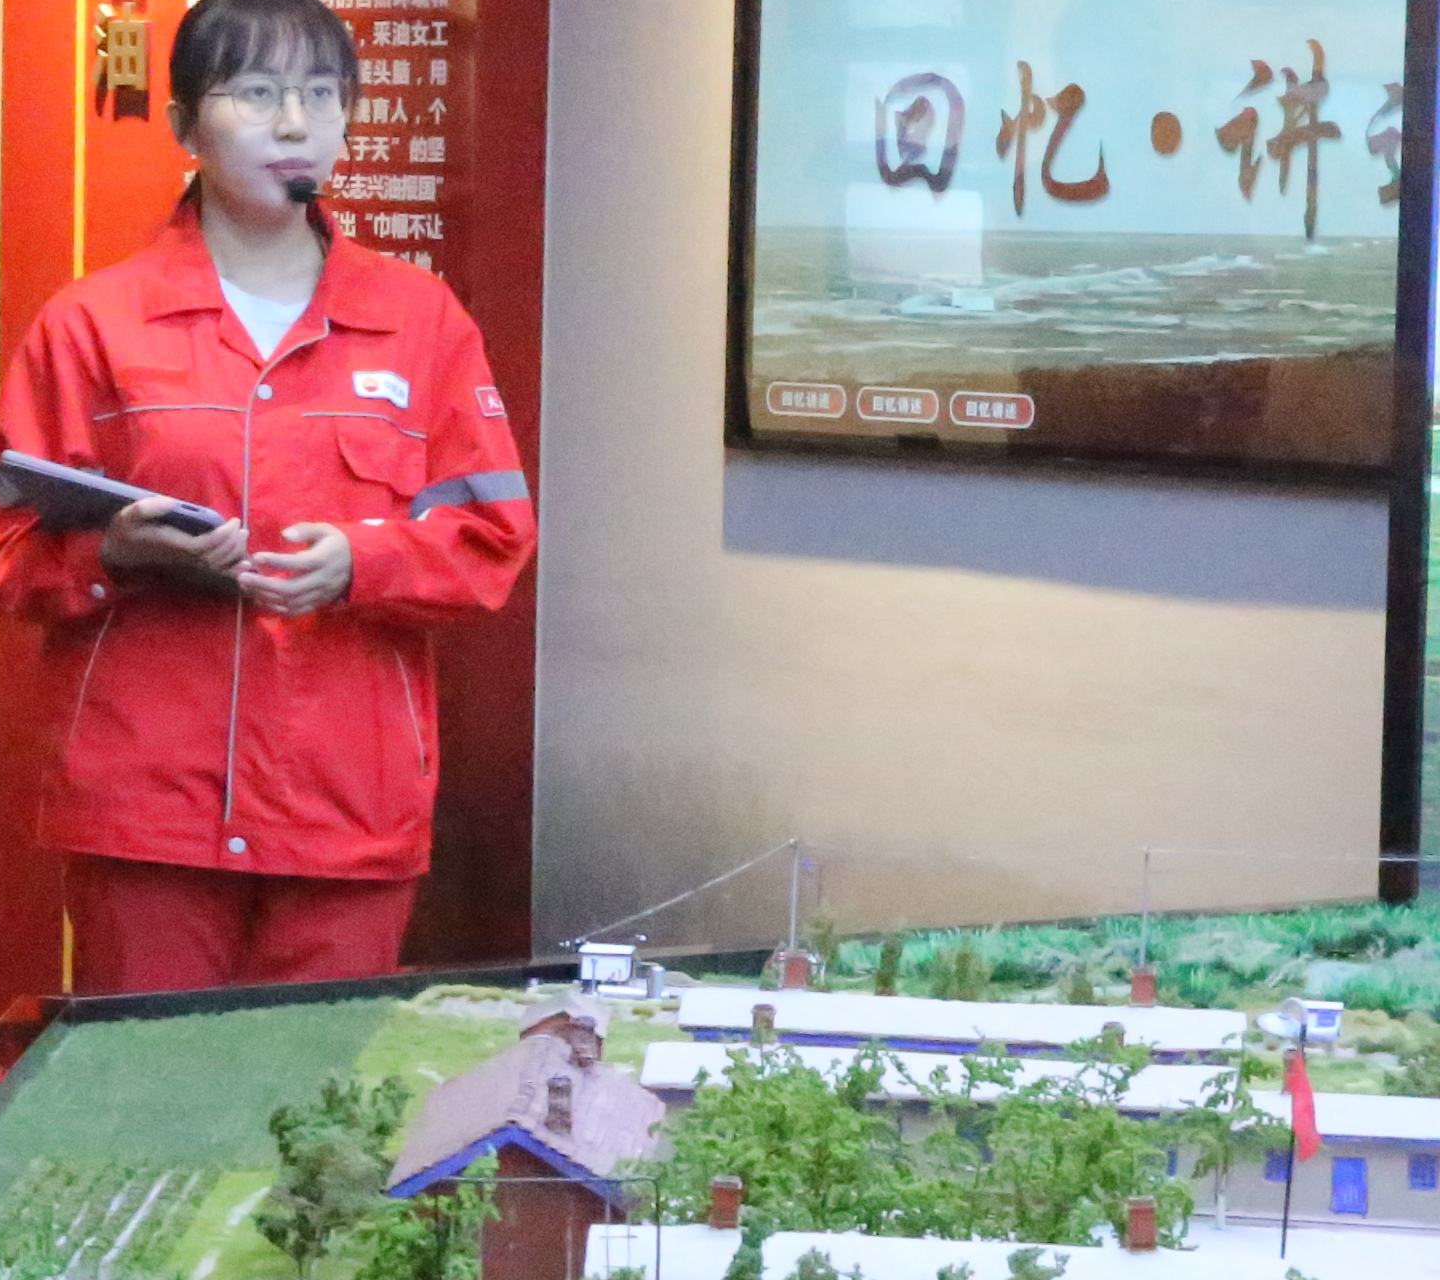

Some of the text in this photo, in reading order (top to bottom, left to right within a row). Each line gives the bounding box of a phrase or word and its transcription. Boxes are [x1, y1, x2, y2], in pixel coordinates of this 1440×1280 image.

[781, 389, 830, 410] 回忆讲述
[872, 395, 922, 415] 回忆讲述
[965, 400, 1018, 420] 回忆讲述
